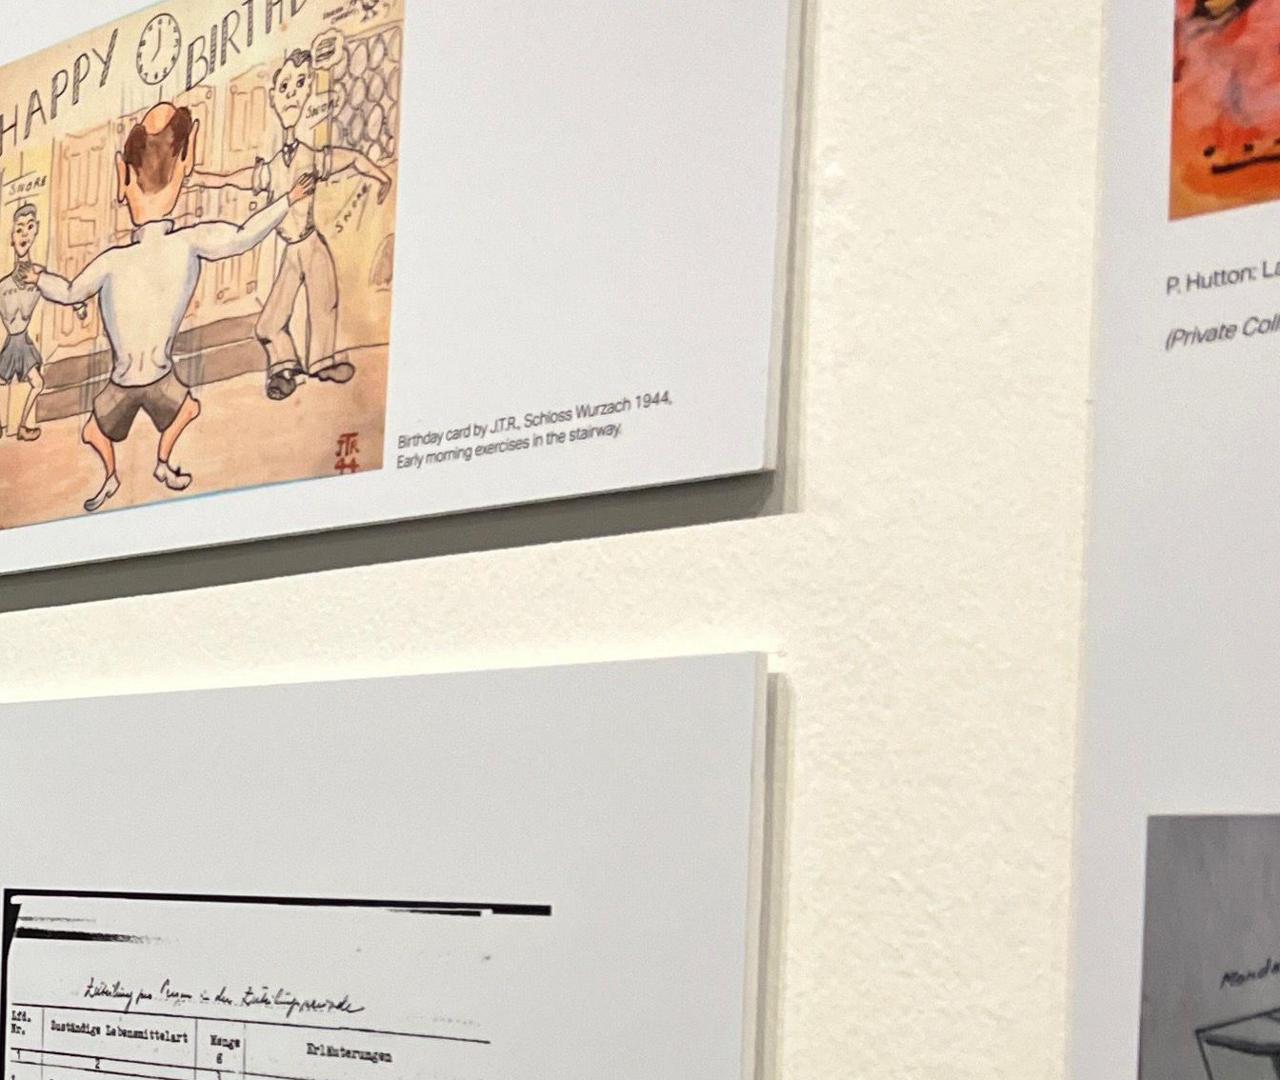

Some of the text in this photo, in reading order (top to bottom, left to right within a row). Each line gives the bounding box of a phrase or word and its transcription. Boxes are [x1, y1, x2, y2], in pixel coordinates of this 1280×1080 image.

[8, 175, 48, 196] SNORE
[1166, 276, 1182, 296] P.
[1186, 266, 1257, 292] Hutton:
[1165, 314, 1280, 351] (Private Coll
[397, 390, 672, 449] Birthday card by J.T.R., Schloss Wurzach 1944,
[396, 423, 621, 469] Early morning exercises in the stairway.
